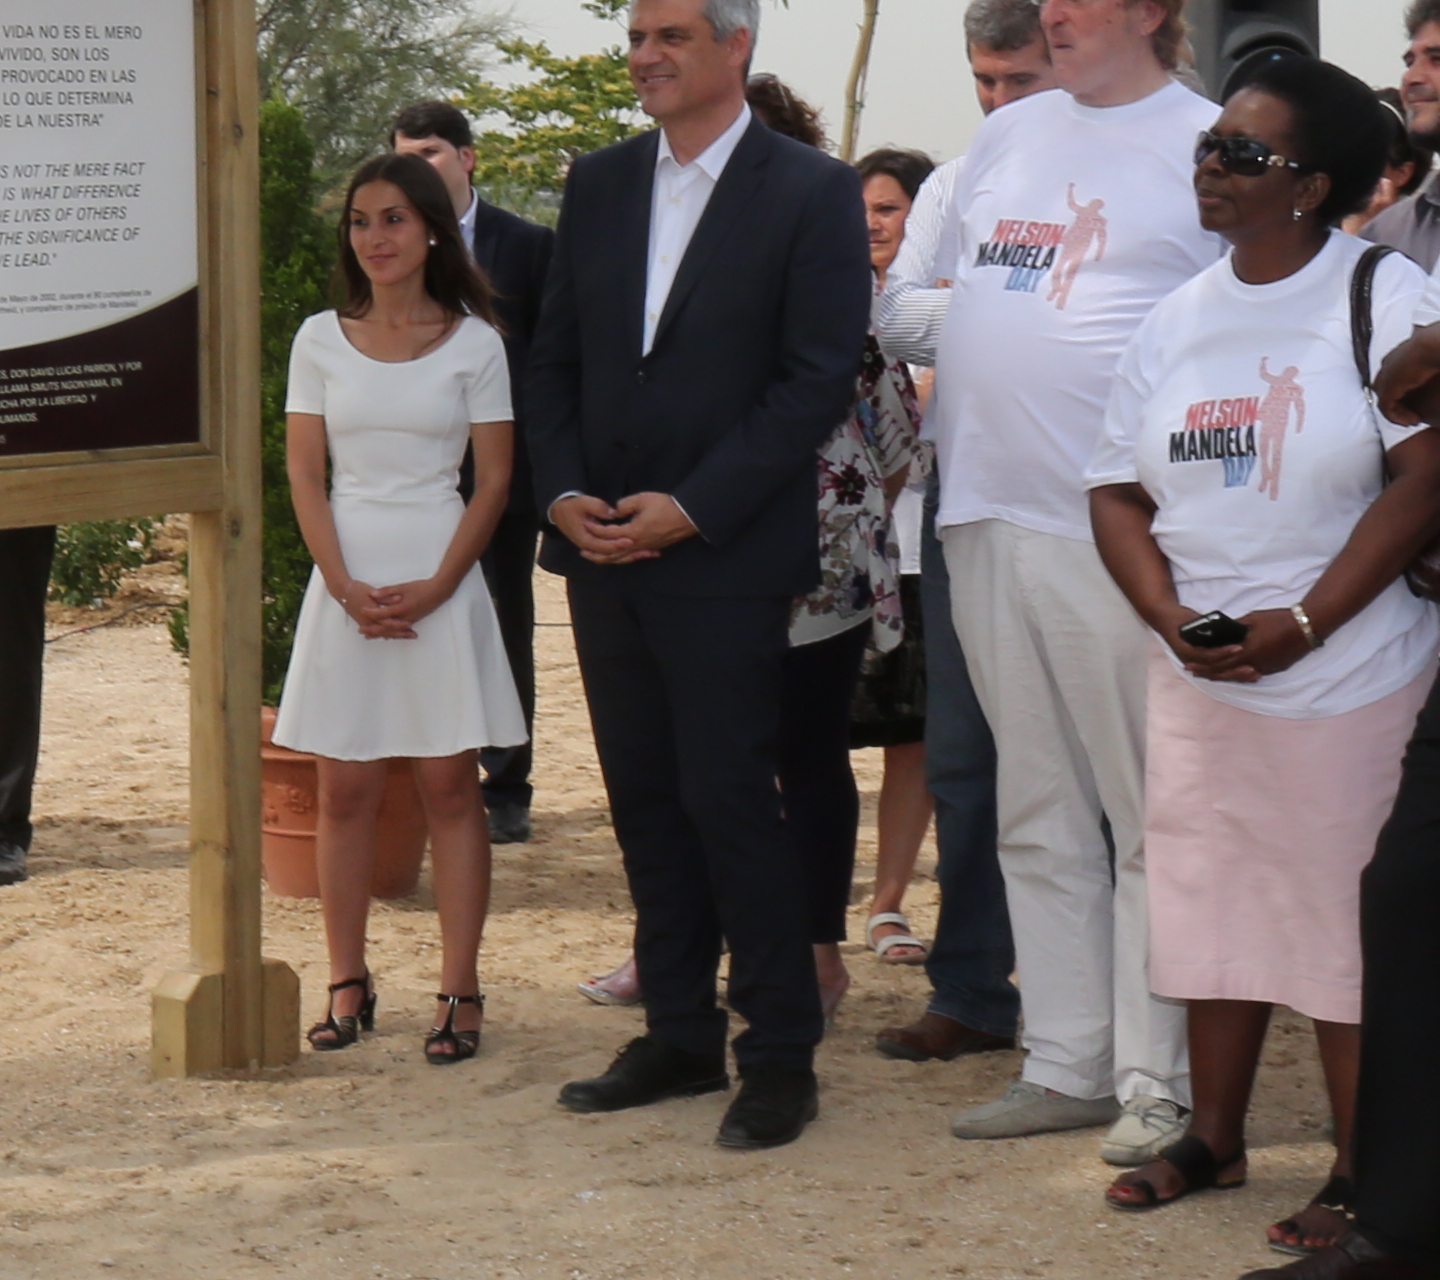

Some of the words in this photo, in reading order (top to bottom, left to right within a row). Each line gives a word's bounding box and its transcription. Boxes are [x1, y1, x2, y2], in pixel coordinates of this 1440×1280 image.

[2, 25, 35, 39] VIDA
[38, 25, 59, 39] NO
[63, 25, 81, 39] ES
[84, 25, 100, 39] EL
[104, 25, 143, 39] MERO
[50, 47, 80, 61] SON
[84, 47, 110, 61] LOS
[1, 70, 85, 83] PROVOCADO
[89, 70, 107, 83] EN
[112, 70, 137, 83] LAS
[2, 92, 20, 106] LO
[24, 92, 53, 106] QUE
[57, 92, 134, 106] DETERMINA
[16, 114, 34, 128] LA
[14, 165, 41, 178] NOT
[46, 164, 70, 177] THE
[74, 163, 110, 176] MERE
[113, 162, 144, 175] FACT
[4, 187, 15, 200] IS
[21, 186, 60, 200] WHAT
[63, 184, 141, 199] DIFFERENCE
[14, 208, 50, 222] LIVES
[55, 208, 73, 220] OF
[77, 207, 127, 220] OTHERS
[27, 228, 119, 244] SIGNIFICANCE
[122, 228, 140, 240] OF
[990, 219, 1066, 247] NELSON
[973, 242, 1056, 270] MANDELA
[1003, 267, 1048, 293] DAY
[11, 369, 28, 378] DON
[30, 367, 54, 377] DAVID
[56, 365, 82, 375] LUCAS
[126, 362, 142, 370] POR
[20, 398, 36, 407] POR
[38, 396, 49, 406] LA
[51, 394, 88, 405] LIBERTAD
[91, 394, 97, 402] Y
[1185, 396, 1261, 431] NELSON
[1170, 425, 1257, 463] MANDELA
[1222, 456, 1257, 488] DAY
